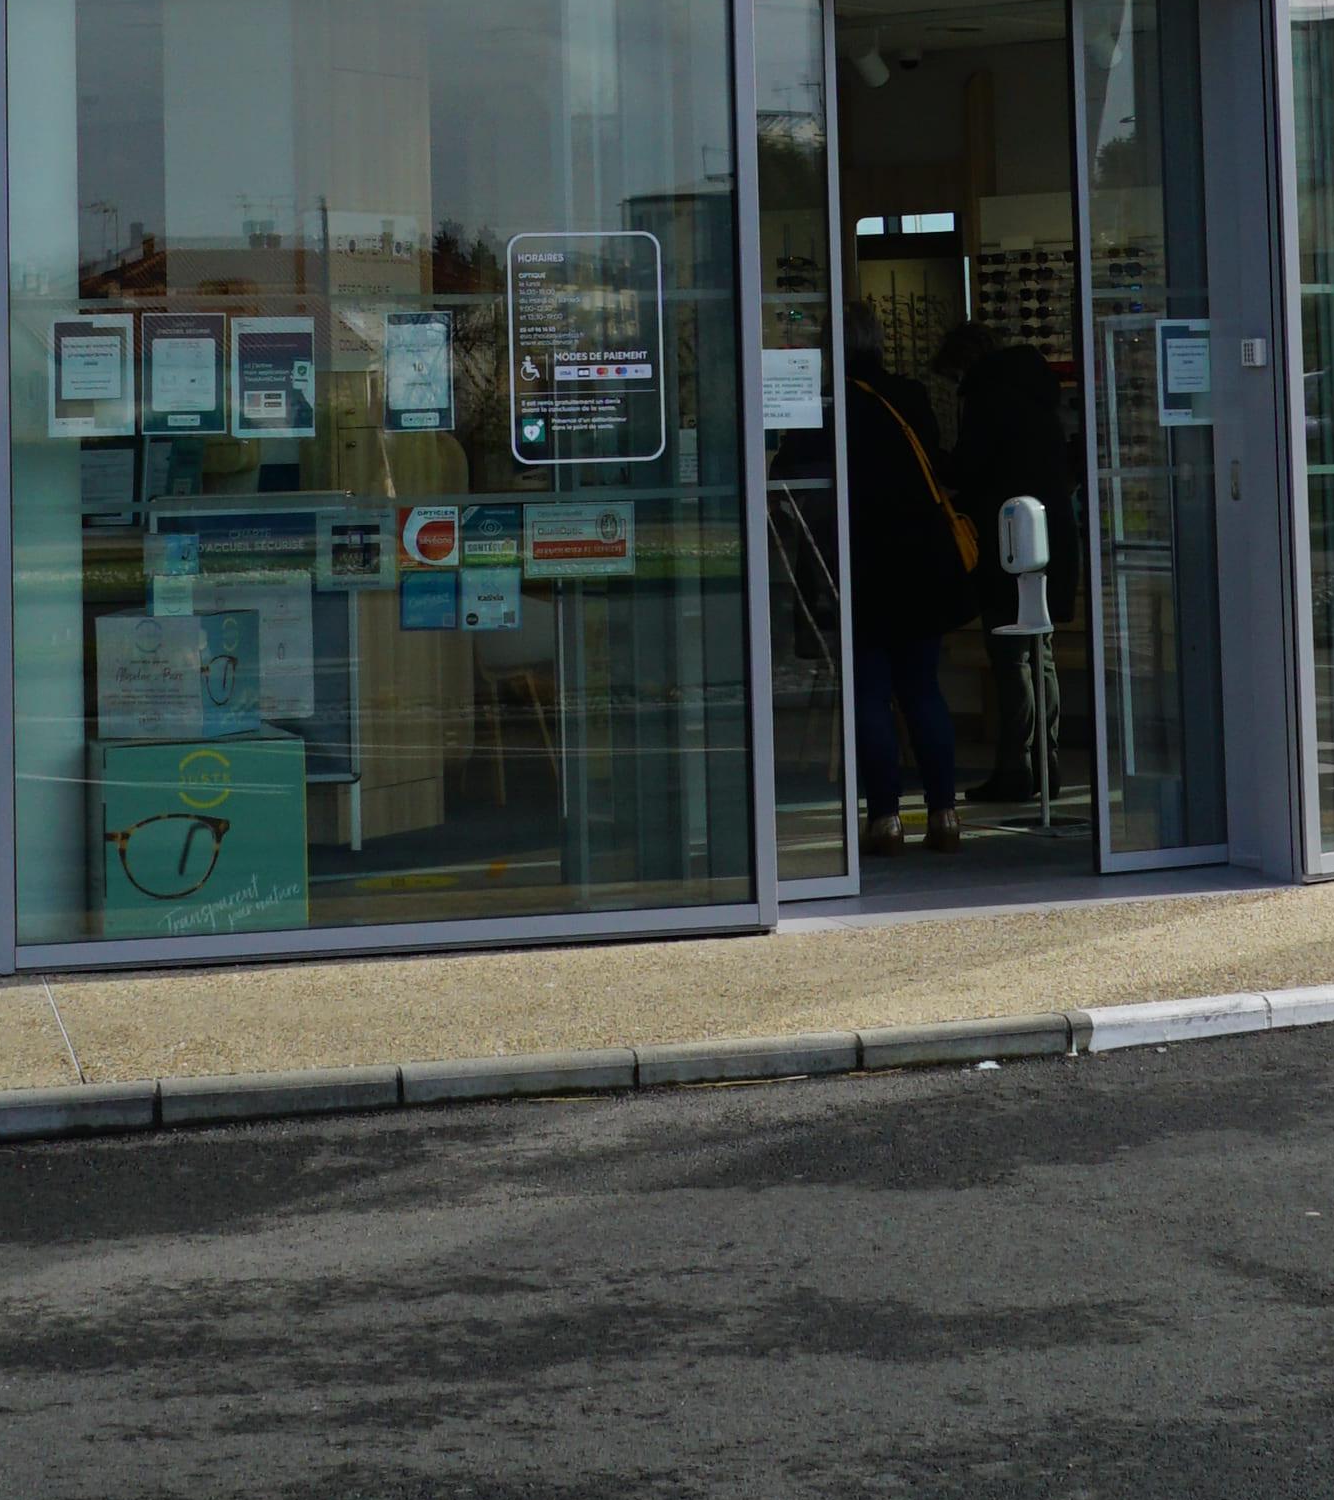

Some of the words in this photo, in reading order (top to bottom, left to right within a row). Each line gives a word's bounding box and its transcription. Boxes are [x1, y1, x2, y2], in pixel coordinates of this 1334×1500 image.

[517, 252, 565, 264] HORAIRES
[554, 352, 588, 362] MODES
[589, 352, 601, 361] DE
[603, 351, 648, 361] PAIEMENT
[417, 509, 455, 517] OPTICIEN
[158, 873, 259, 933] Transparent
